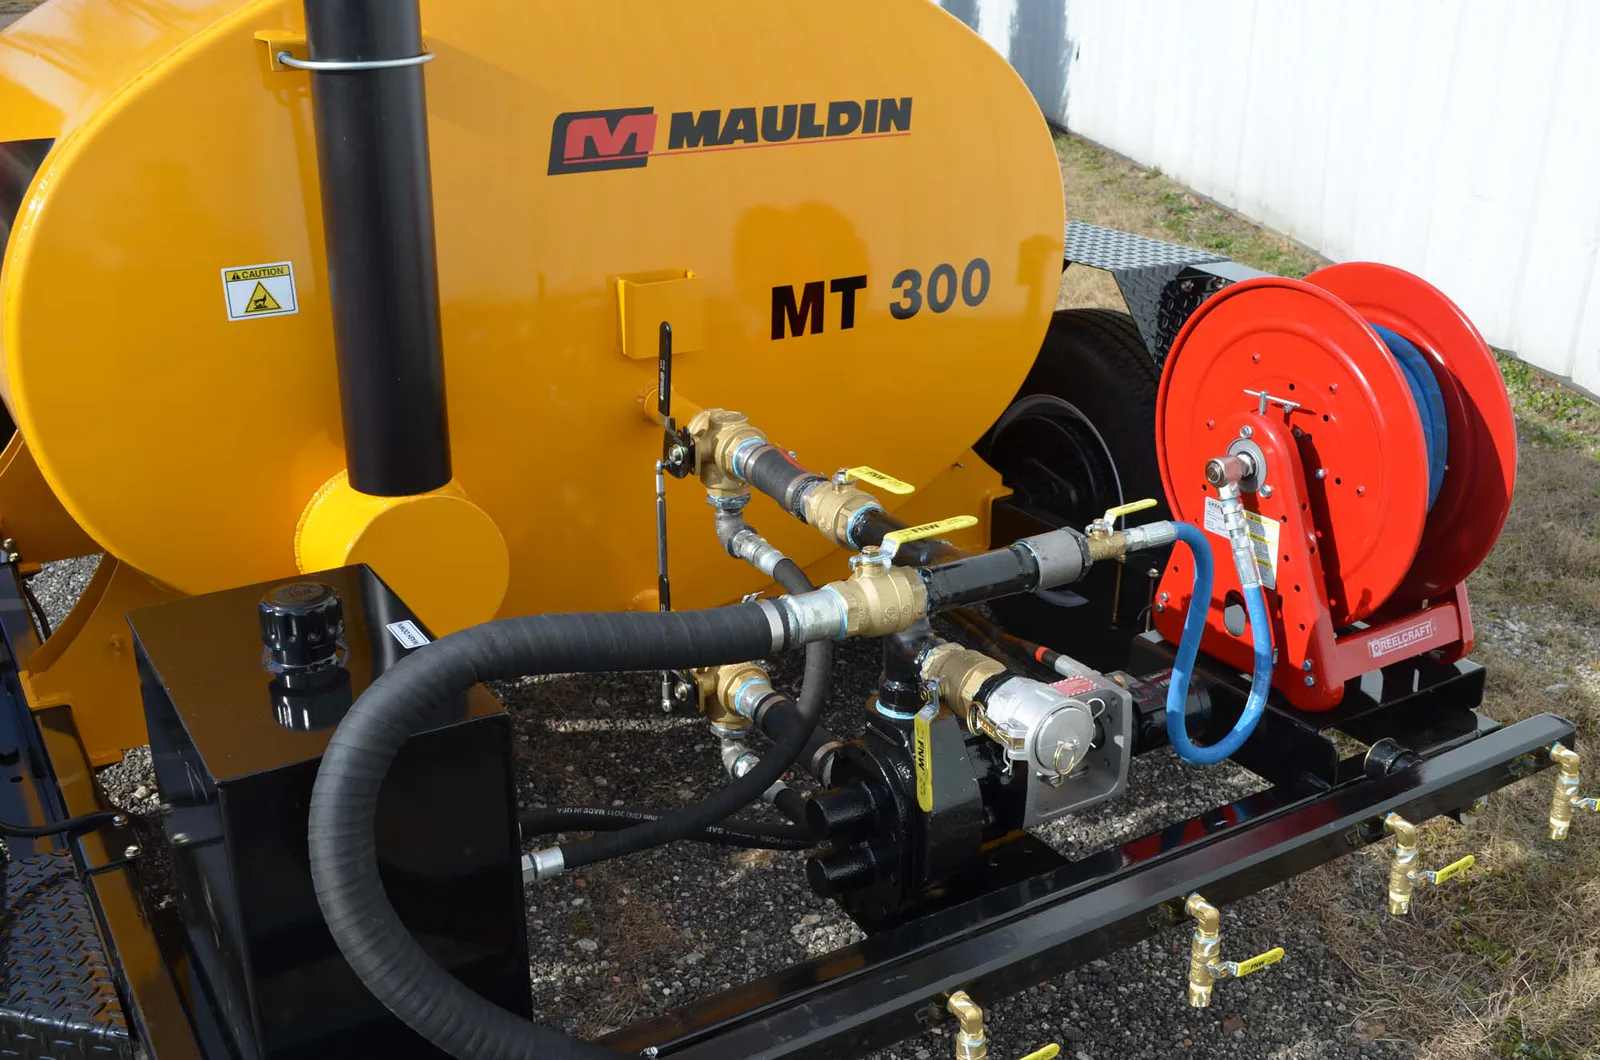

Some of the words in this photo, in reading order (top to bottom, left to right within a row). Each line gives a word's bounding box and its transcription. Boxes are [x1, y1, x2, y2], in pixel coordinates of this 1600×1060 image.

[668, 97, 913, 151] MAULDIN
[241, 267, 284, 279] CAUTION
[770, 274, 868, 341] MT
[889, 257, 991, 320] 300
[1380, 624, 1432, 651] REELCRAFT
[917, 740, 925, 771] FNW
[583, 807, 605, 816] MADE
